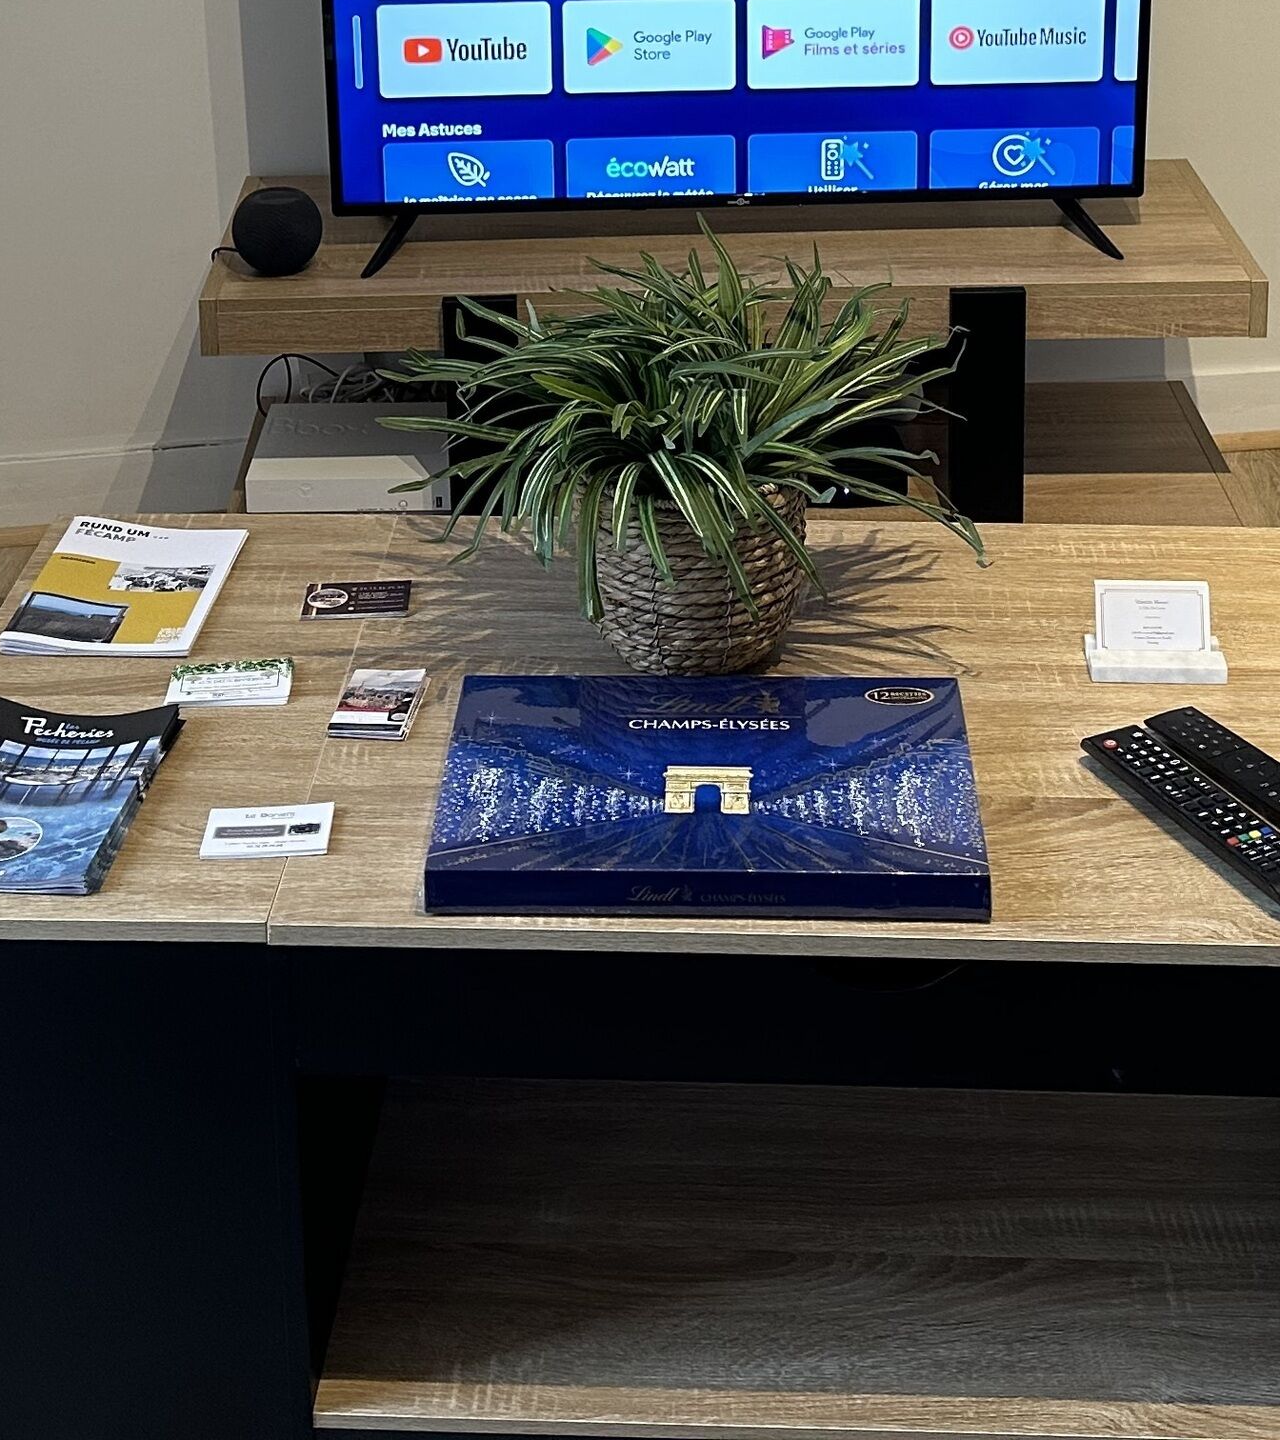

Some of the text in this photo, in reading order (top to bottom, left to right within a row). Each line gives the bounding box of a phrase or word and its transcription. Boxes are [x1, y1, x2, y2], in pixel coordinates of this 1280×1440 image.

[633, 30, 712, 46] Google Play
[804, 26, 875, 41] Google Play
[977, 27, 1087, 47] YouTube Music
[446, 36, 527, 62] YouTube
[634, 48, 671, 60] Store
[804, 42, 906, 56] Films et séries
[382, 123, 482, 138] Mes Astuces
[605, 155, 695, 178] écowatt
[75, 527, 137, 543] FÉCAMP
[79, 521, 151, 538] RUND UM
[628, 717, 791, 731] CHAMPS-ÉLYSÉES
[626, 885, 680, 902] Lindt
